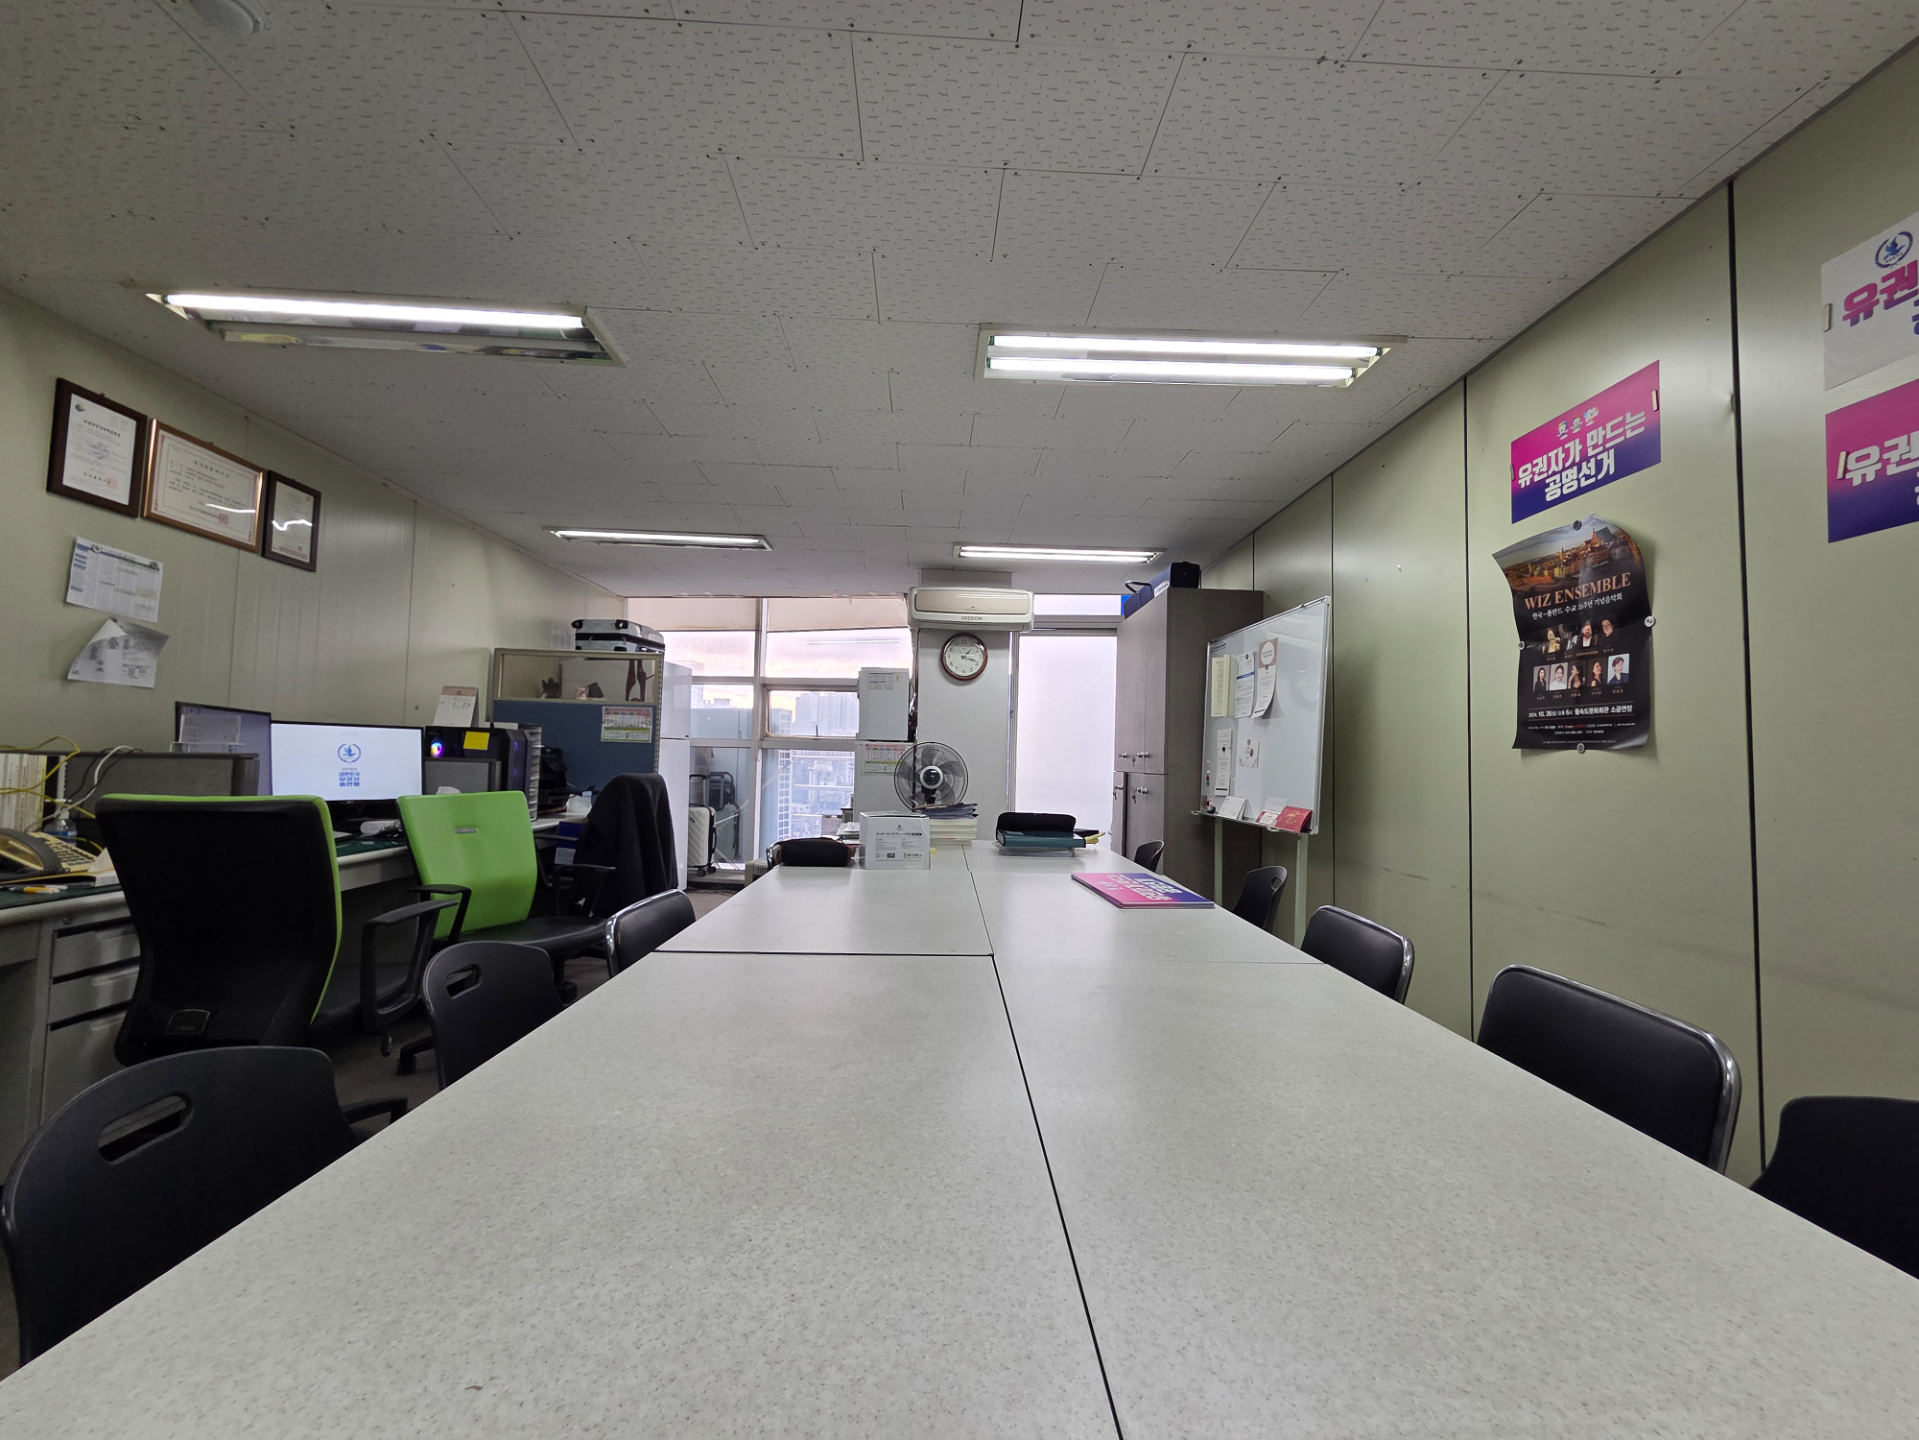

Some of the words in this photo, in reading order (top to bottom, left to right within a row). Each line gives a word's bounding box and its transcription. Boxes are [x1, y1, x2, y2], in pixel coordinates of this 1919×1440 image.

[1518, 438, 1582, 489] 유권자가
[1586, 411, 1647, 457] 만드는
[1544, 448, 1615, 502] 공명선거
[1524, 593, 1552, 610] WIZ
[1555, 572, 1631, 605] ENSEMBLE
